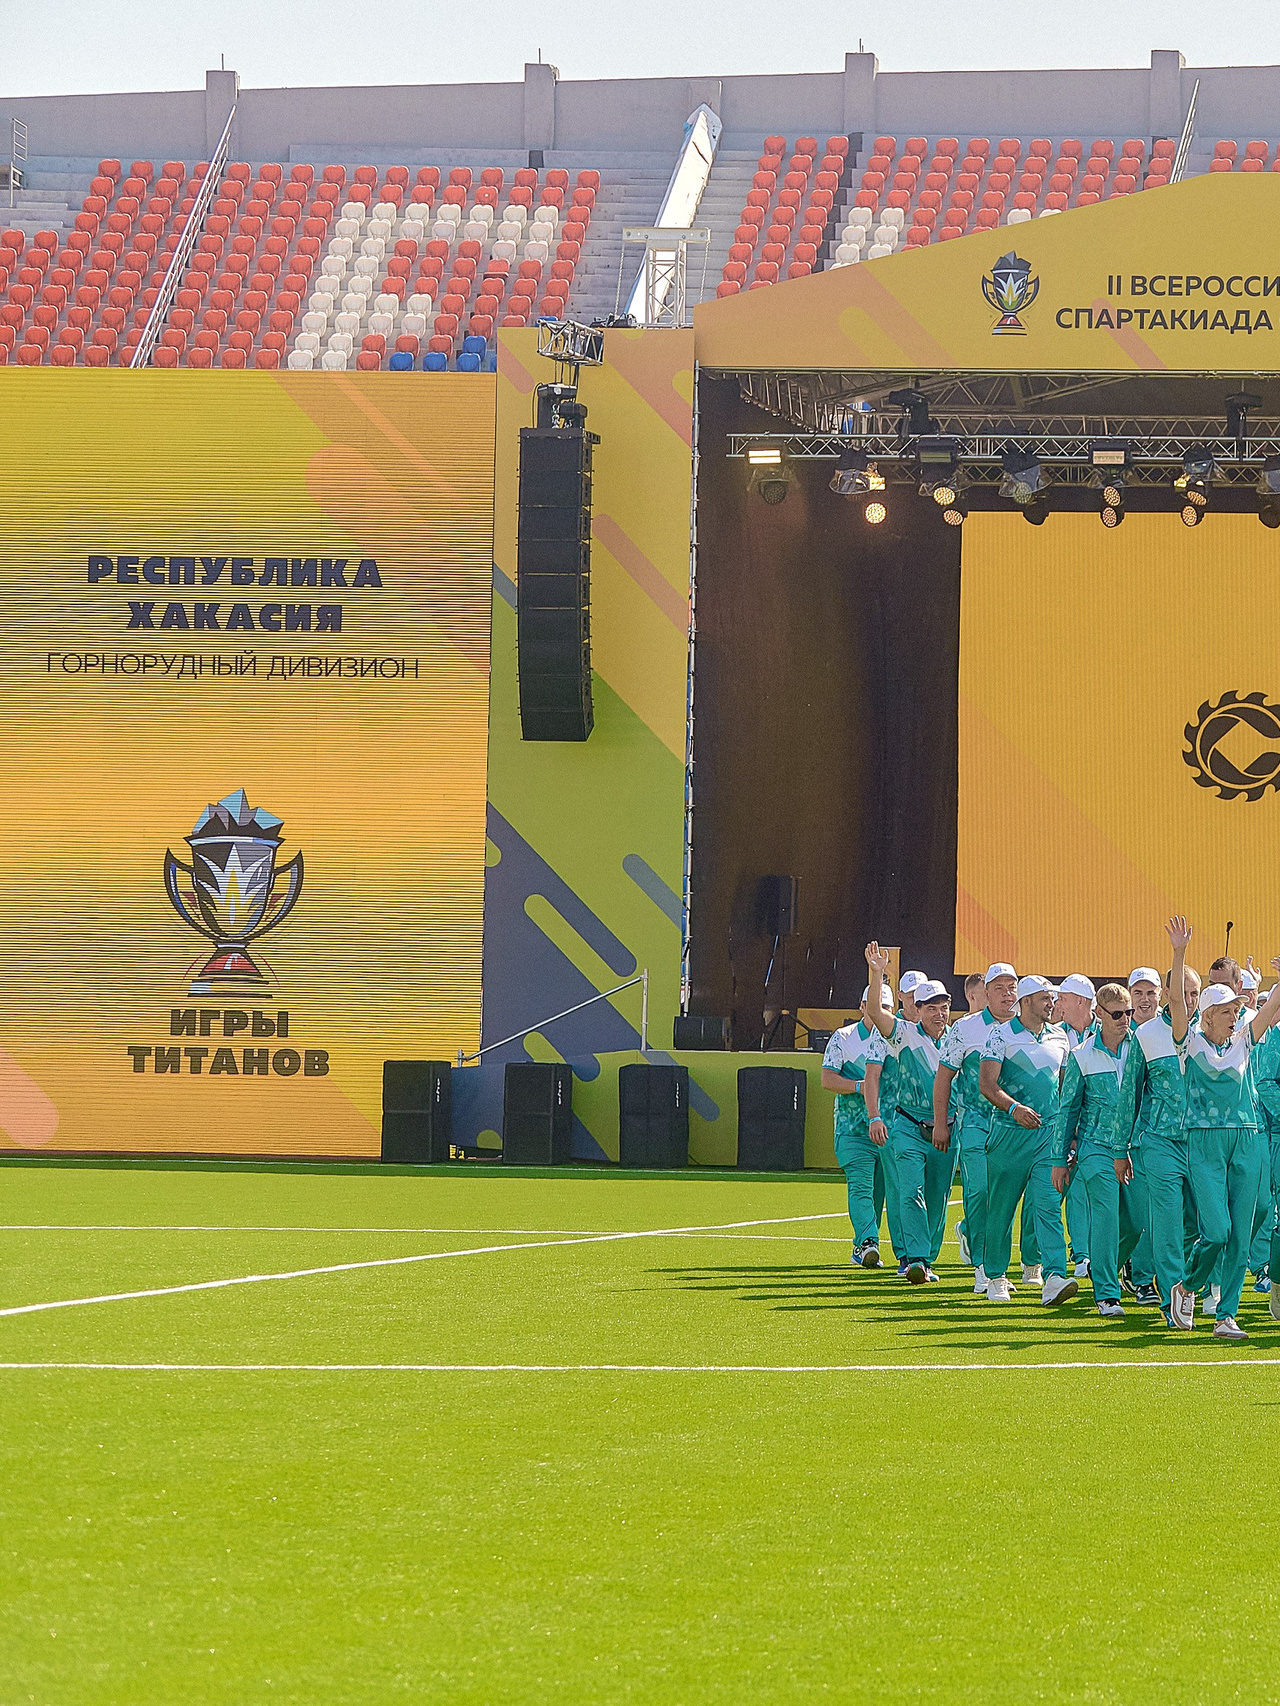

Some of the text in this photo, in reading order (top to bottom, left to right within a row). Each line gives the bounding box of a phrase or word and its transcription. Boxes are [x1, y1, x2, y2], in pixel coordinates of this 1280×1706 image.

[1055, 307, 1274, 335] СПАРТАКИАДА
[87, 555, 384, 588] РЕСПУБЛИКА
[126, 602, 343, 633] ХАКАСИЯ
[46, 650, 420, 681] ГОРНОРУДНЫЙ ДИВИЗИОН
[169, 1009, 289, 1037] ИГРЫ
[127, 1046, 330, 1076] ТИТАНОВ
